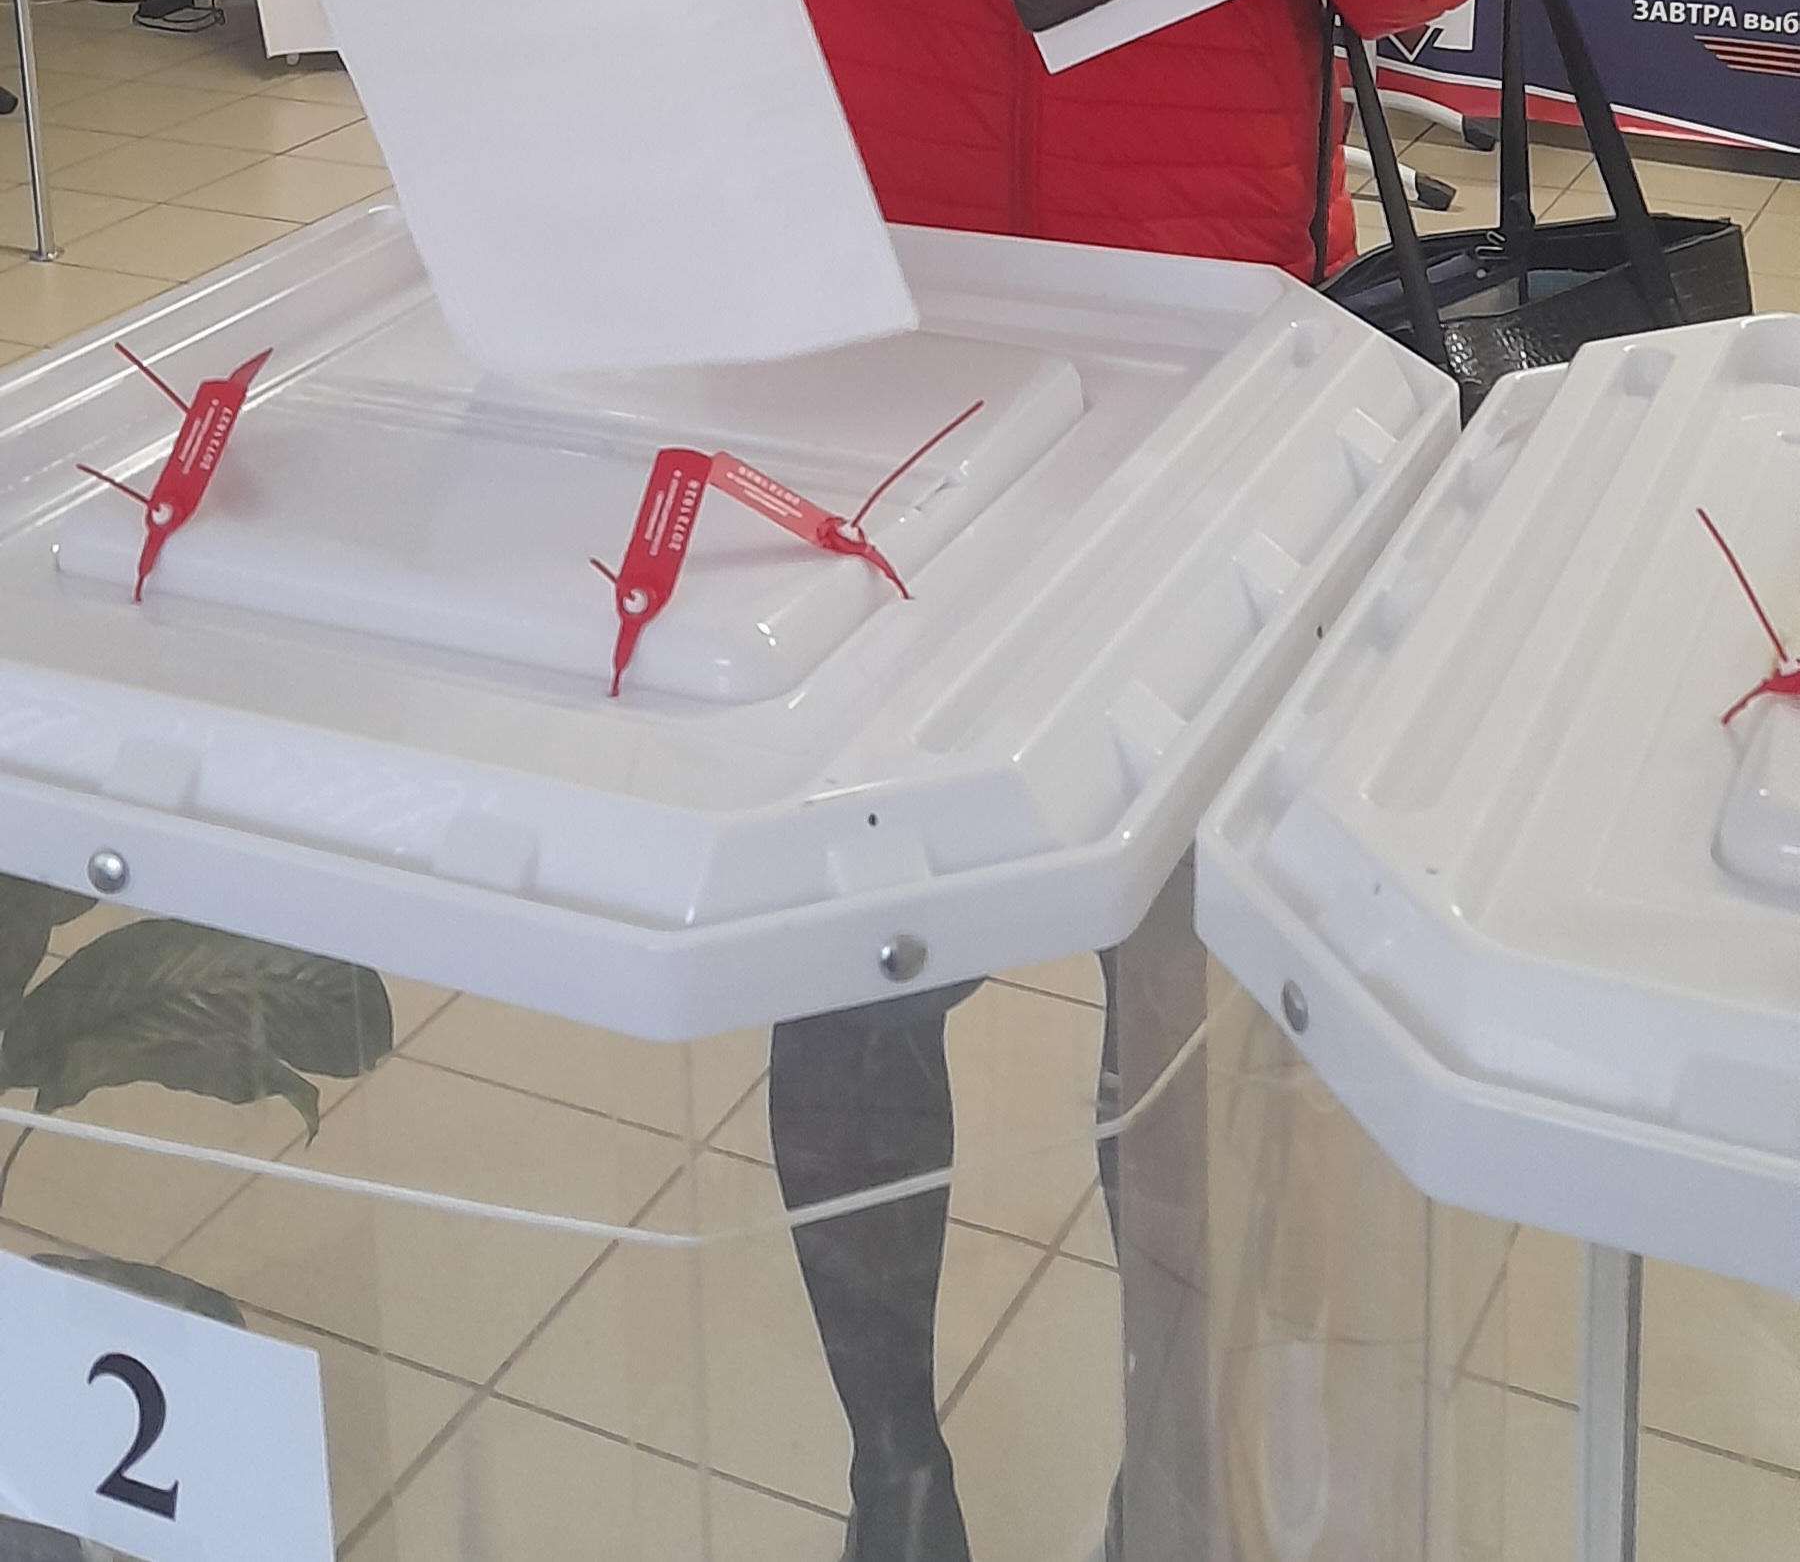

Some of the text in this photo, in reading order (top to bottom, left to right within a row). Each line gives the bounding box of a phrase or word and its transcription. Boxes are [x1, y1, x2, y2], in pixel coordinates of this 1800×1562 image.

[1633, 0, 1800, 35] ЗАВТРА выб
[86, 1352, 179, 1522] 2
